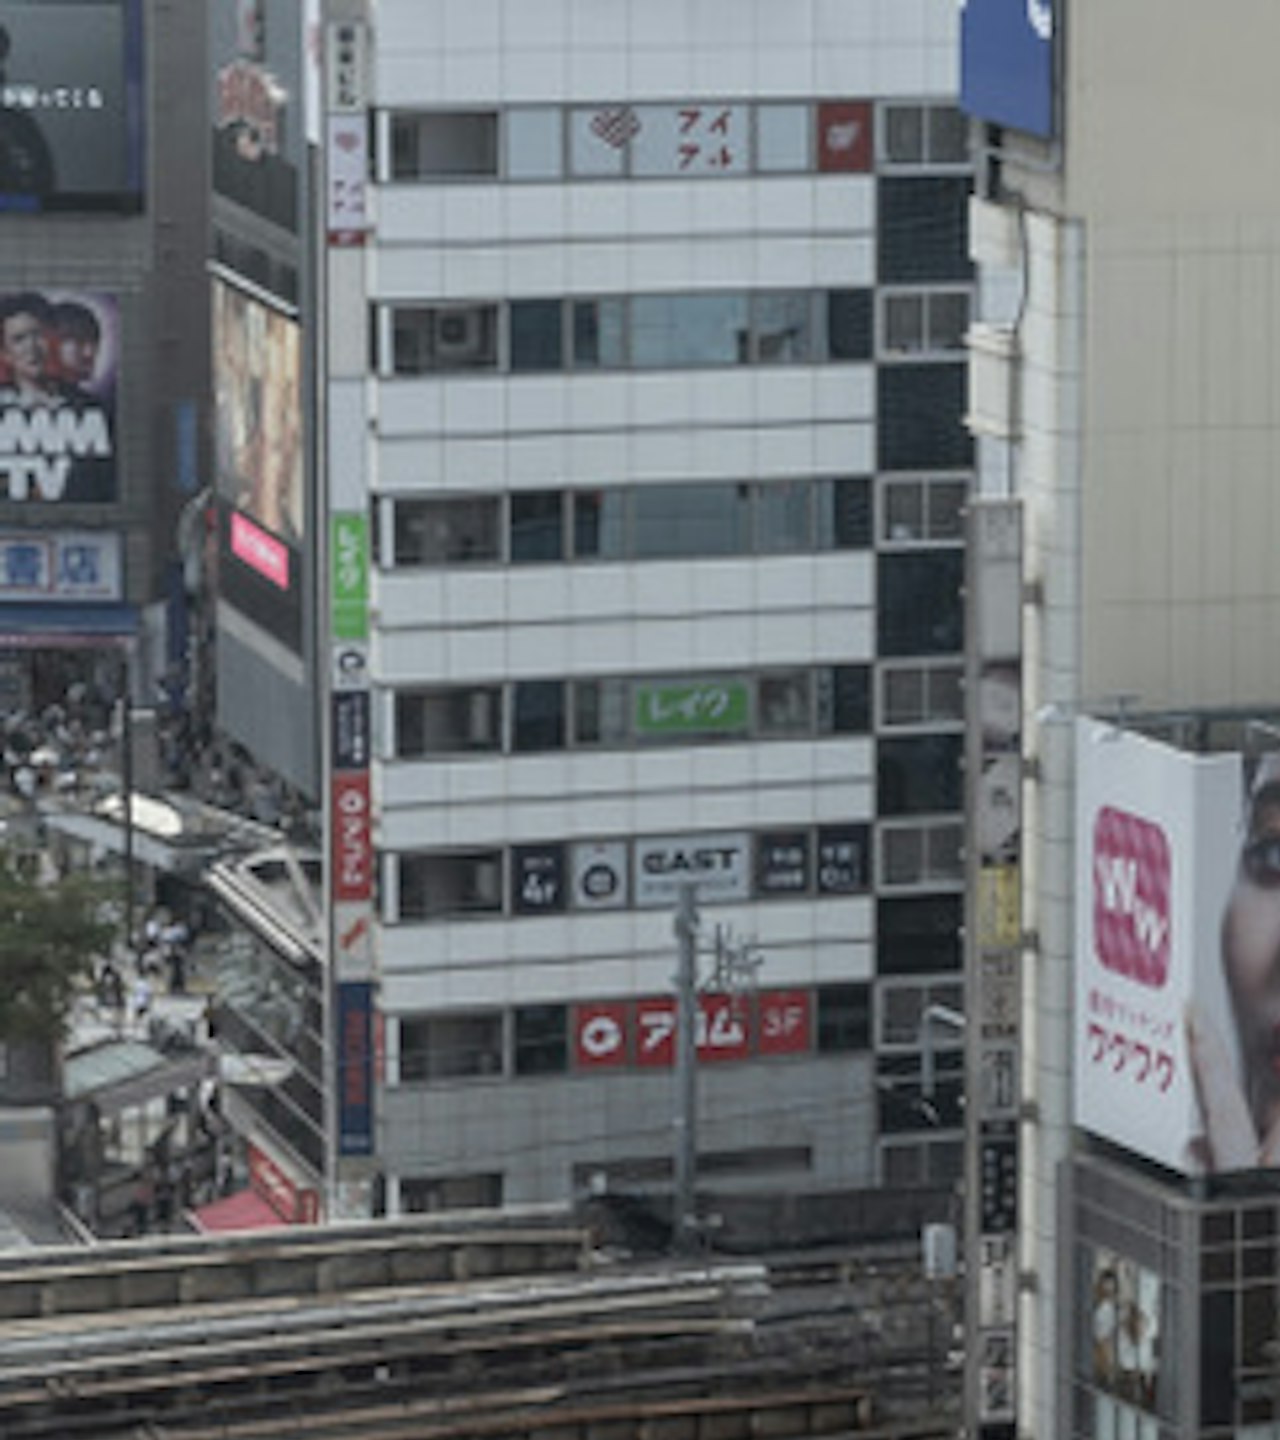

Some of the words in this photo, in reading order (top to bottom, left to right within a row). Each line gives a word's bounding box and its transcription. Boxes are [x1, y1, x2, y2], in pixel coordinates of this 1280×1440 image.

[649, 688, 730, 722] レイク
[1087, 1022, 1176, 1095] ワクワク
